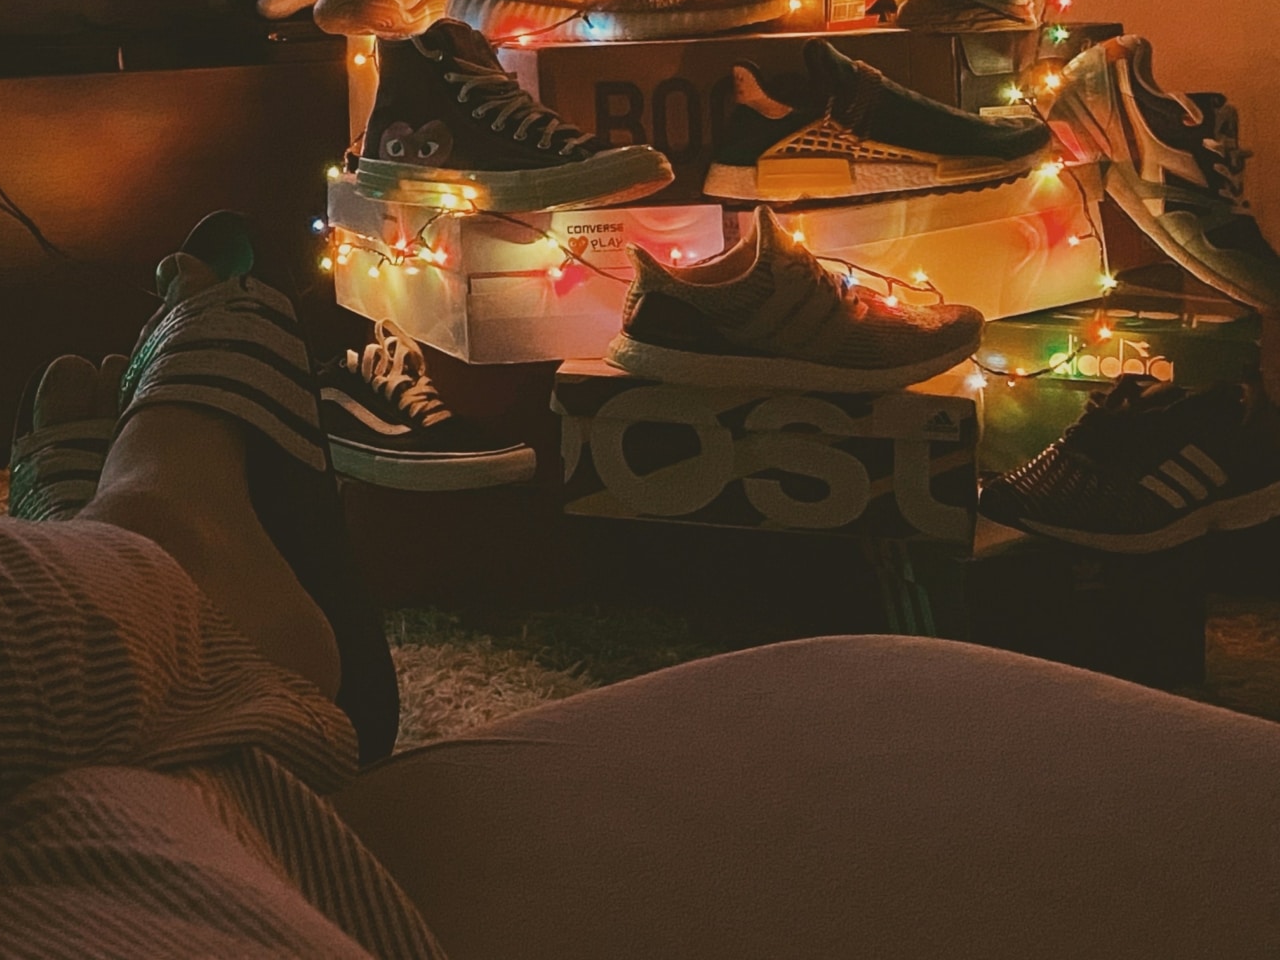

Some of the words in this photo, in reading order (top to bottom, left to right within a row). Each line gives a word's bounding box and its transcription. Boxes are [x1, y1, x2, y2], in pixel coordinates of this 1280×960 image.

[567, 223, 624, 235] CONVERSE
[590, 237, 623, 250] PLAY
[1049, 334, 1174, 383] diadora
